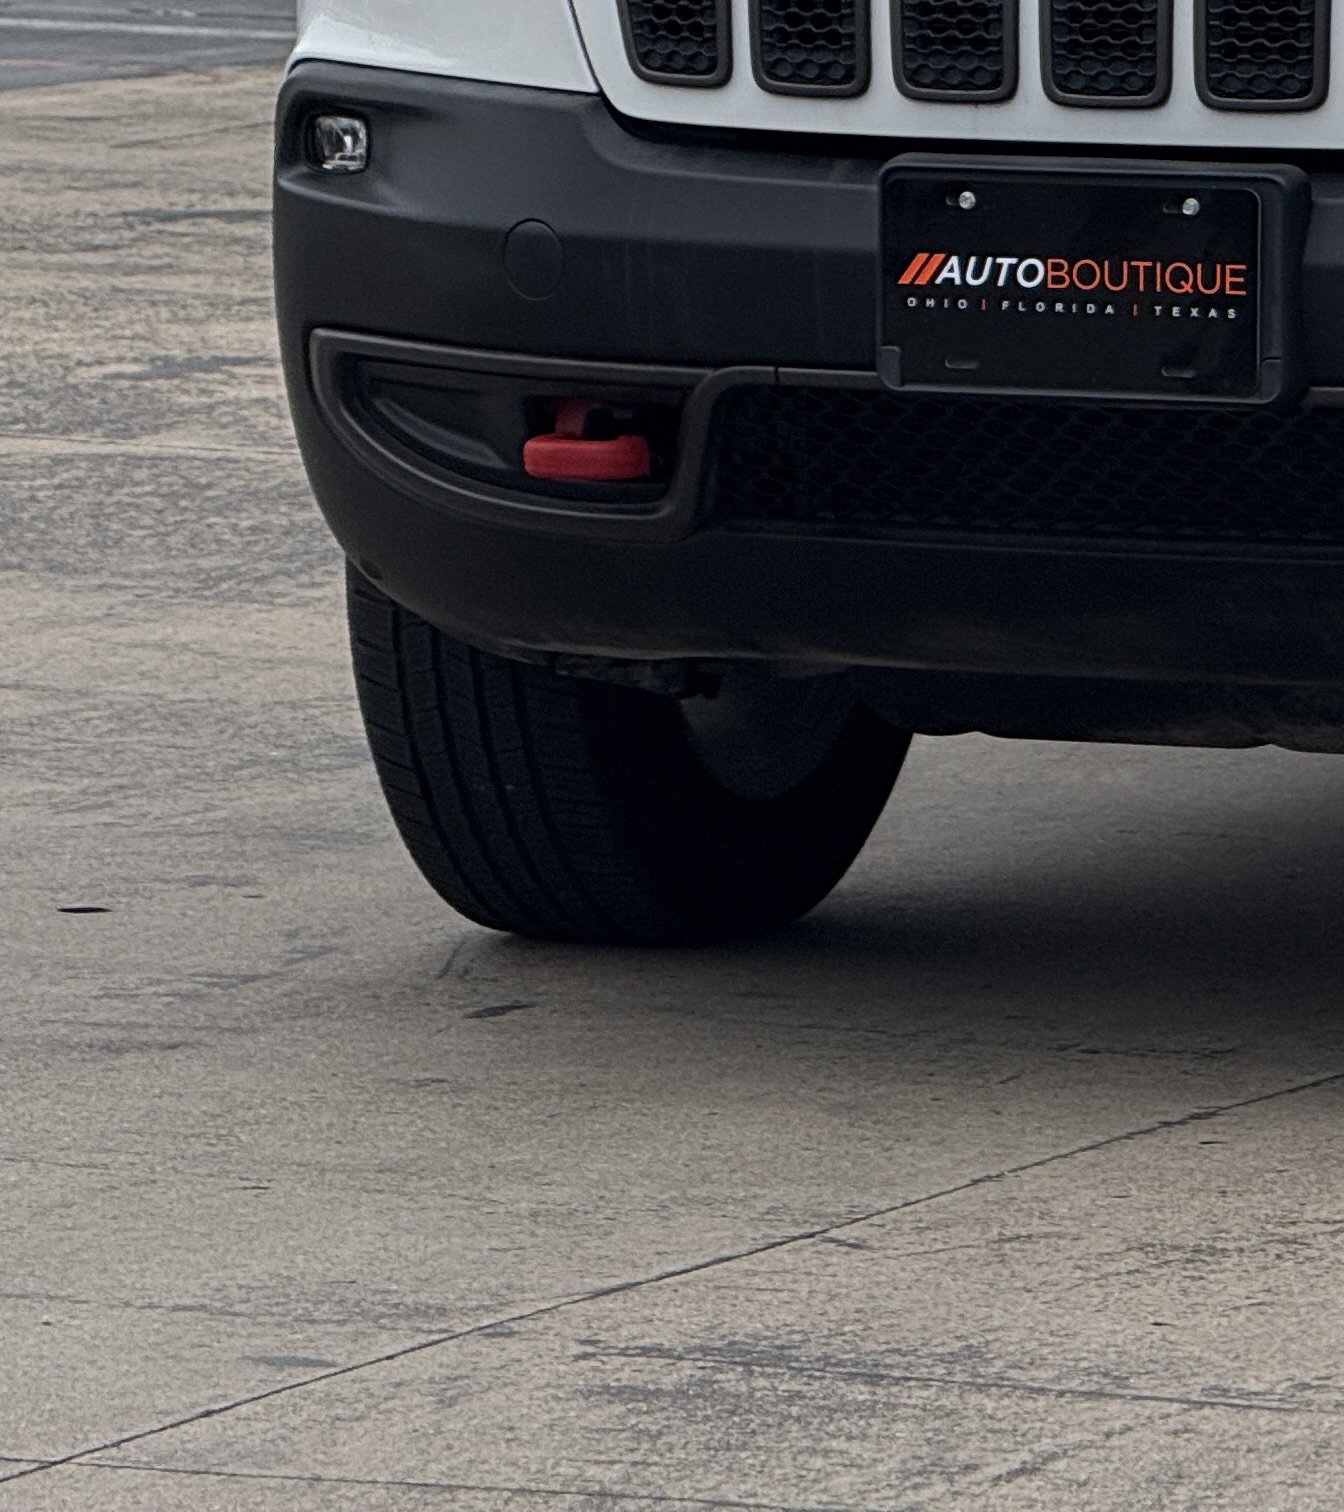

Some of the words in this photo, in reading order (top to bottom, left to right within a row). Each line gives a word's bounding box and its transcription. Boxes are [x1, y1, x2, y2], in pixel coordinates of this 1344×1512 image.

[934, 255, 1248, 297] AUTOBOUTIQUE
[907, 297, 968, 310] OHIO
[1001, 300, 1115, 316] FLORIDA
[1154, 305, 1237, 320] TEXAS
